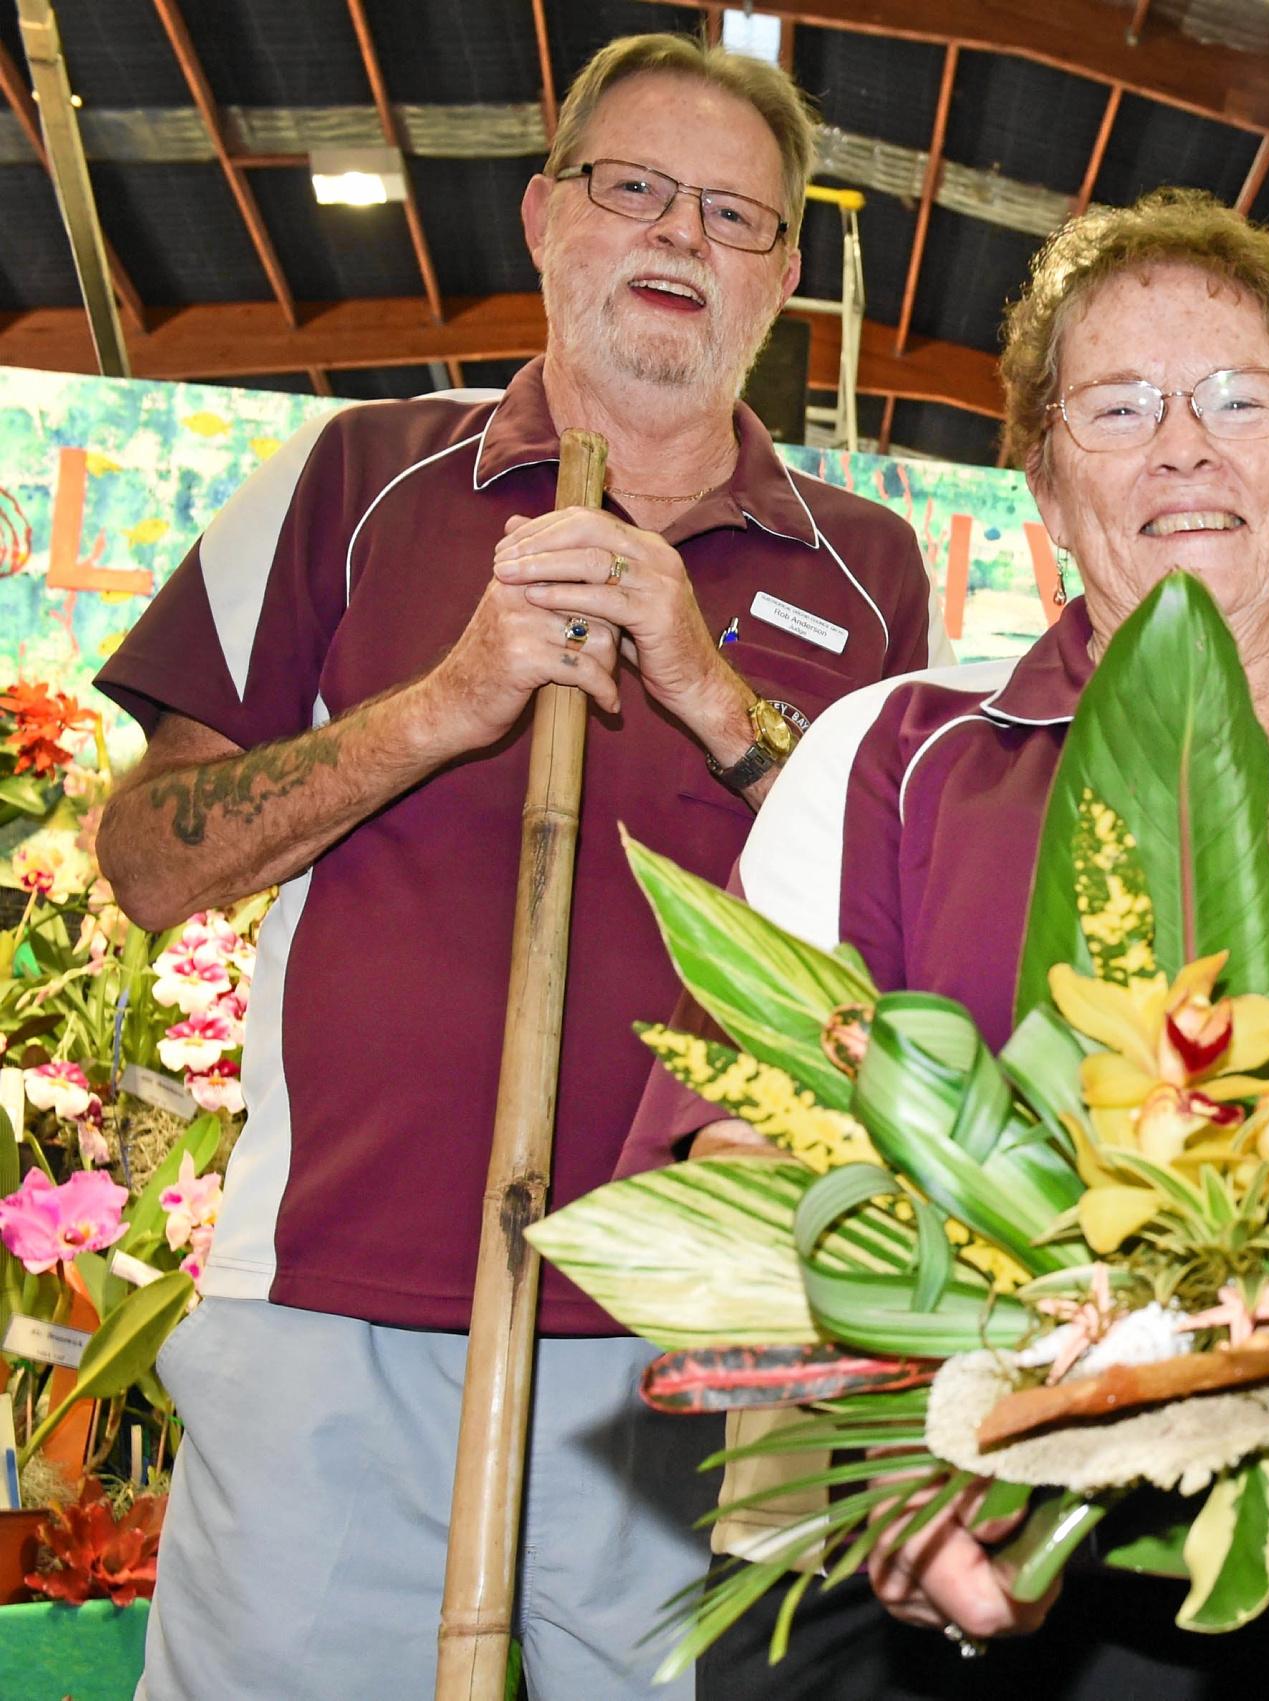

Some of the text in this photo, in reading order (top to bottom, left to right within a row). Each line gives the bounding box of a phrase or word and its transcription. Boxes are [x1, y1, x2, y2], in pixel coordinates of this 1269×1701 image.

[774, 607, 790, 620] Rob
[791, 616, 828, 637] Anderson
[791, 711, 810, 730] BAY
